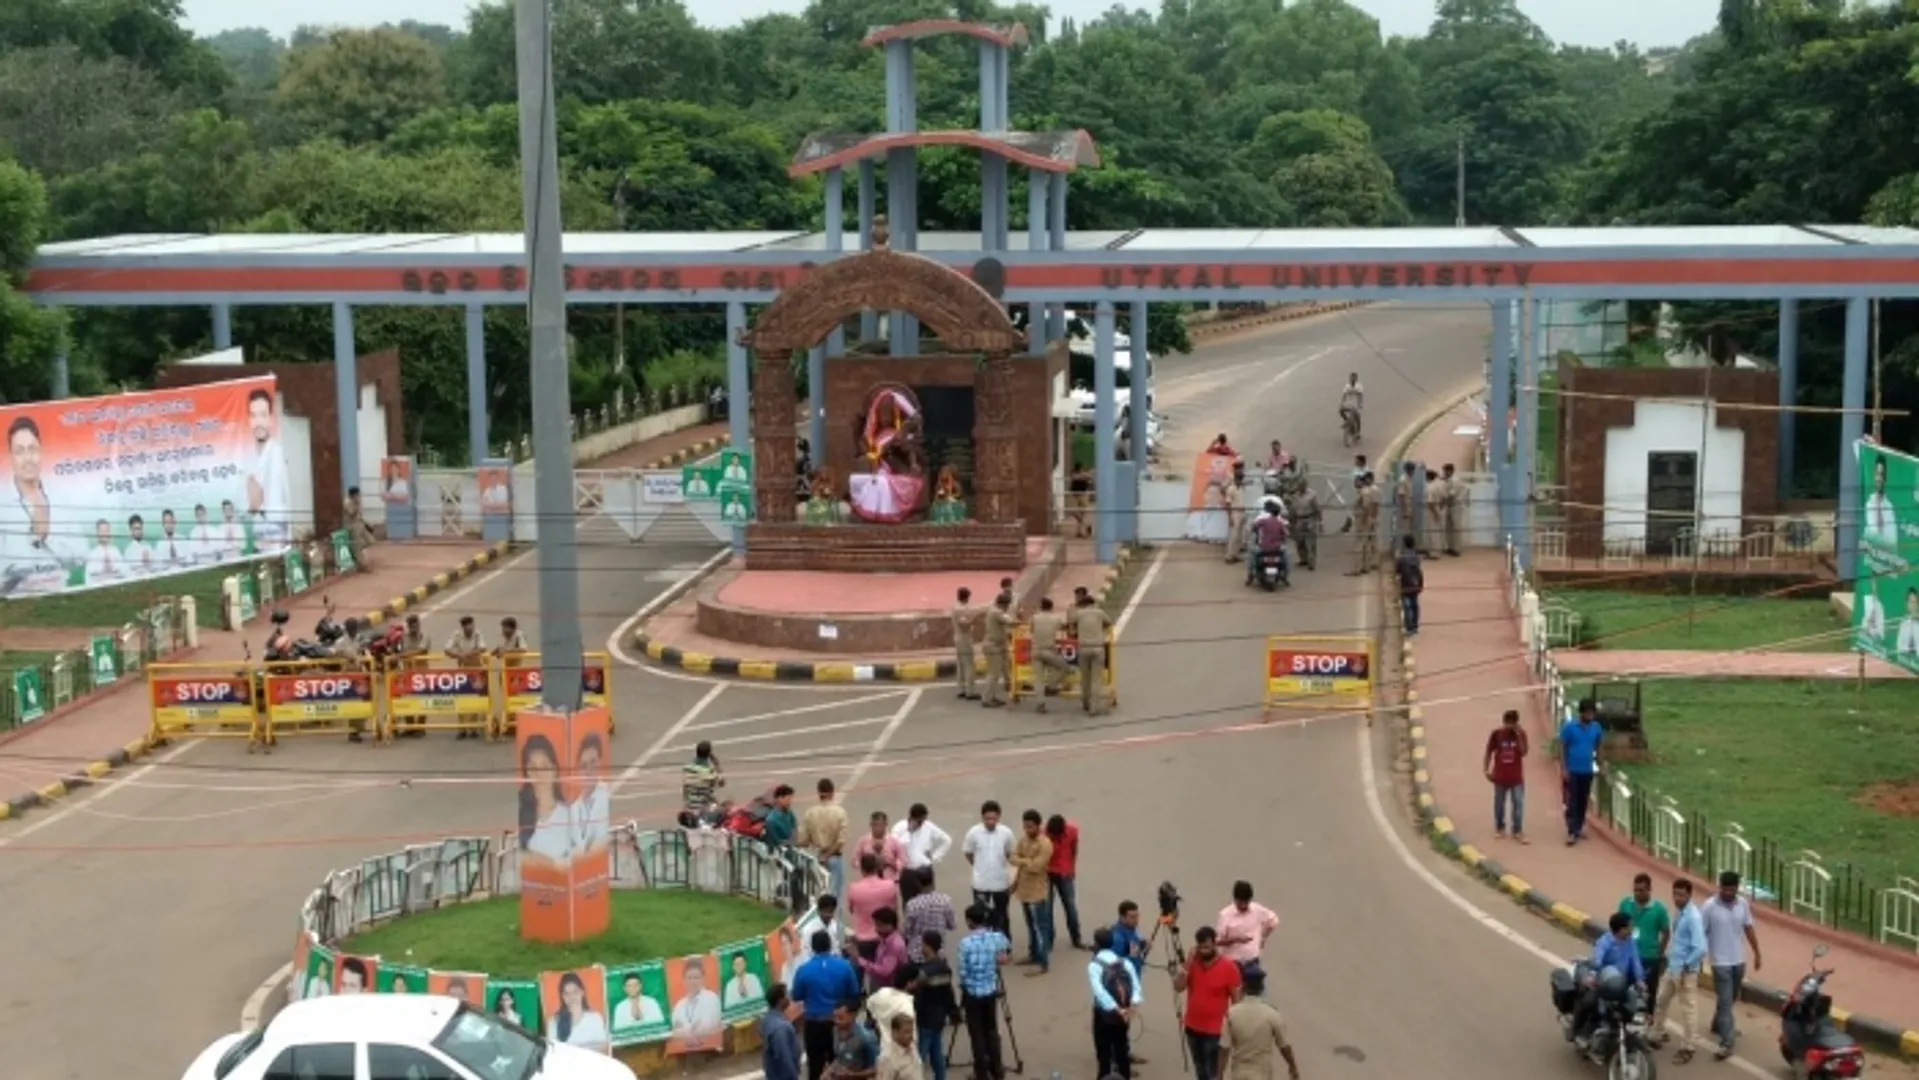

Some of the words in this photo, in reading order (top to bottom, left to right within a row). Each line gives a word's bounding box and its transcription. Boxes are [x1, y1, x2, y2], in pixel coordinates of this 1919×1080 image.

[1101, 264, 1241, 290] UTKAL
[1272, 263, 1536, 289] UNIVERSITY
[1292, 654, 1348, 673] STOP
[175, 681, 232, 701] STOP
[293, 678, 353, 698] STOP
[411, 672, 468, 691] STOP
